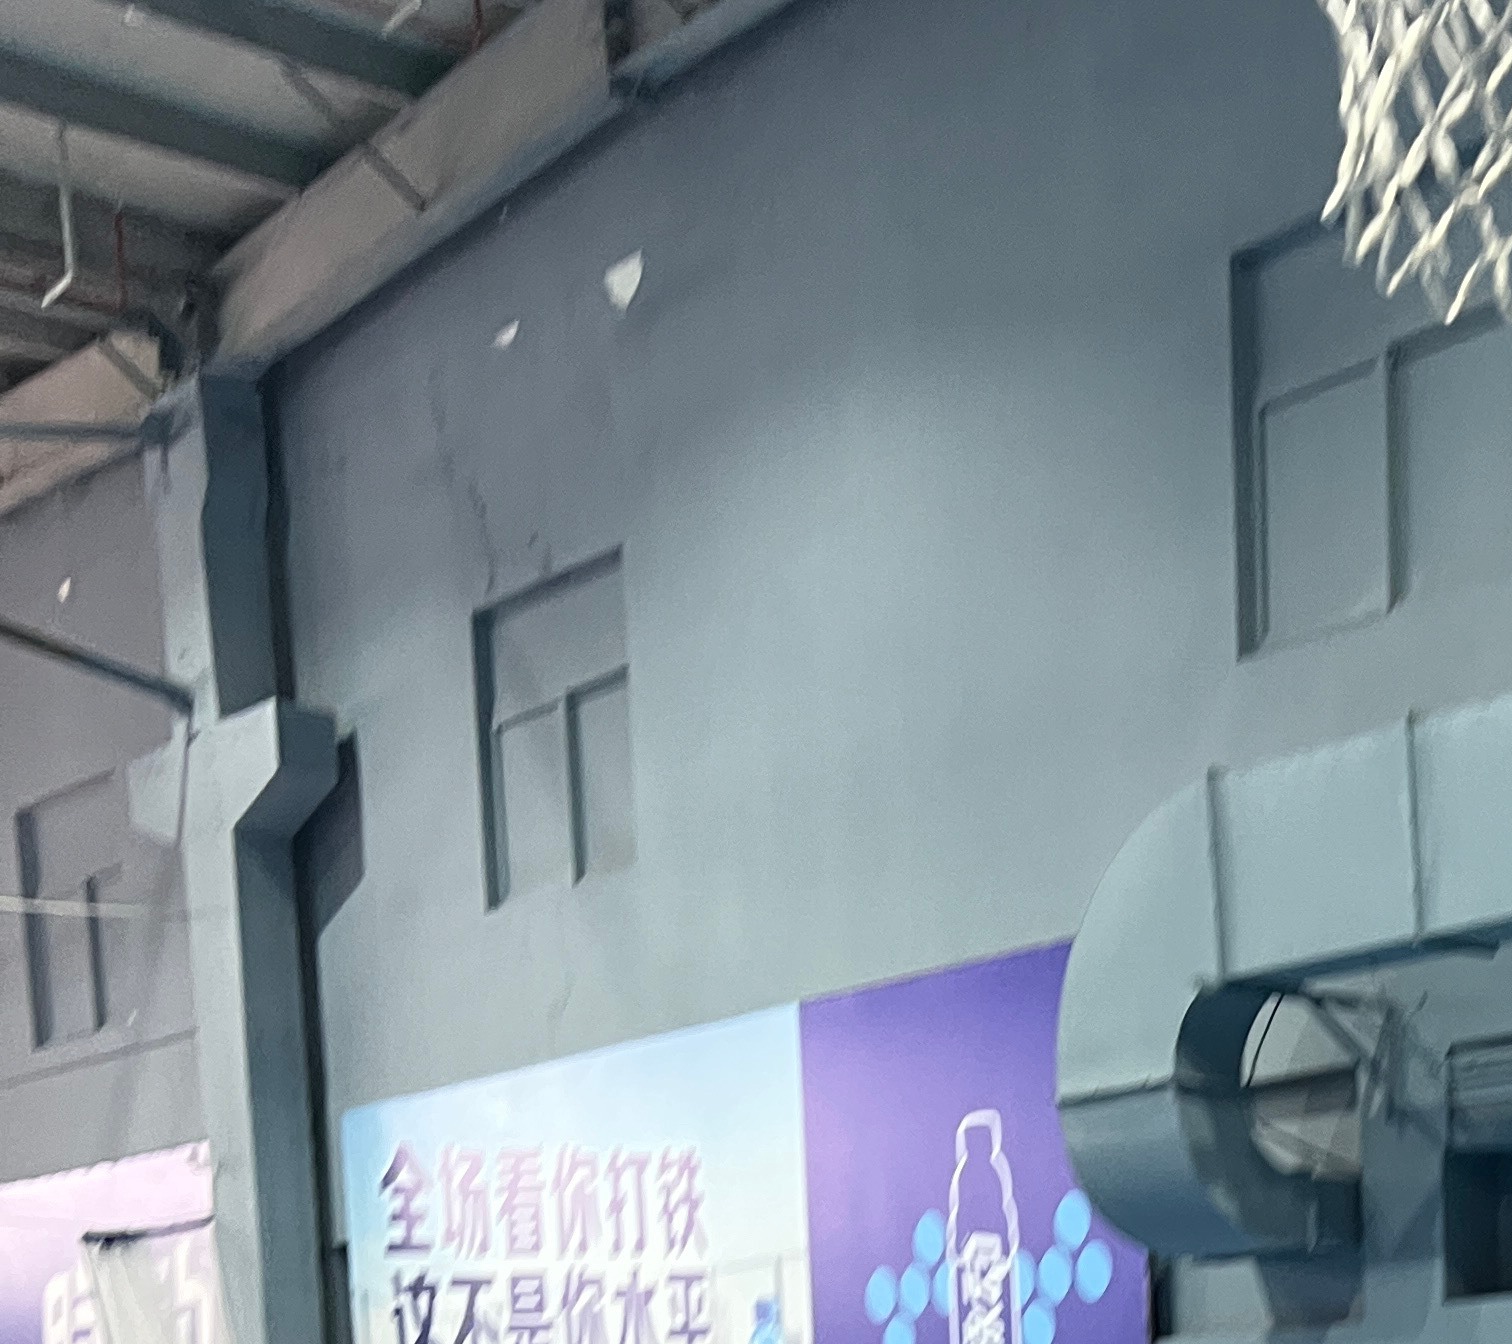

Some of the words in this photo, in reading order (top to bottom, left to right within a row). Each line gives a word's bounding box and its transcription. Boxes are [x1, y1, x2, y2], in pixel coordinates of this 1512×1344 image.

[381, 1141, 705, 1260] 全场看你打铁
